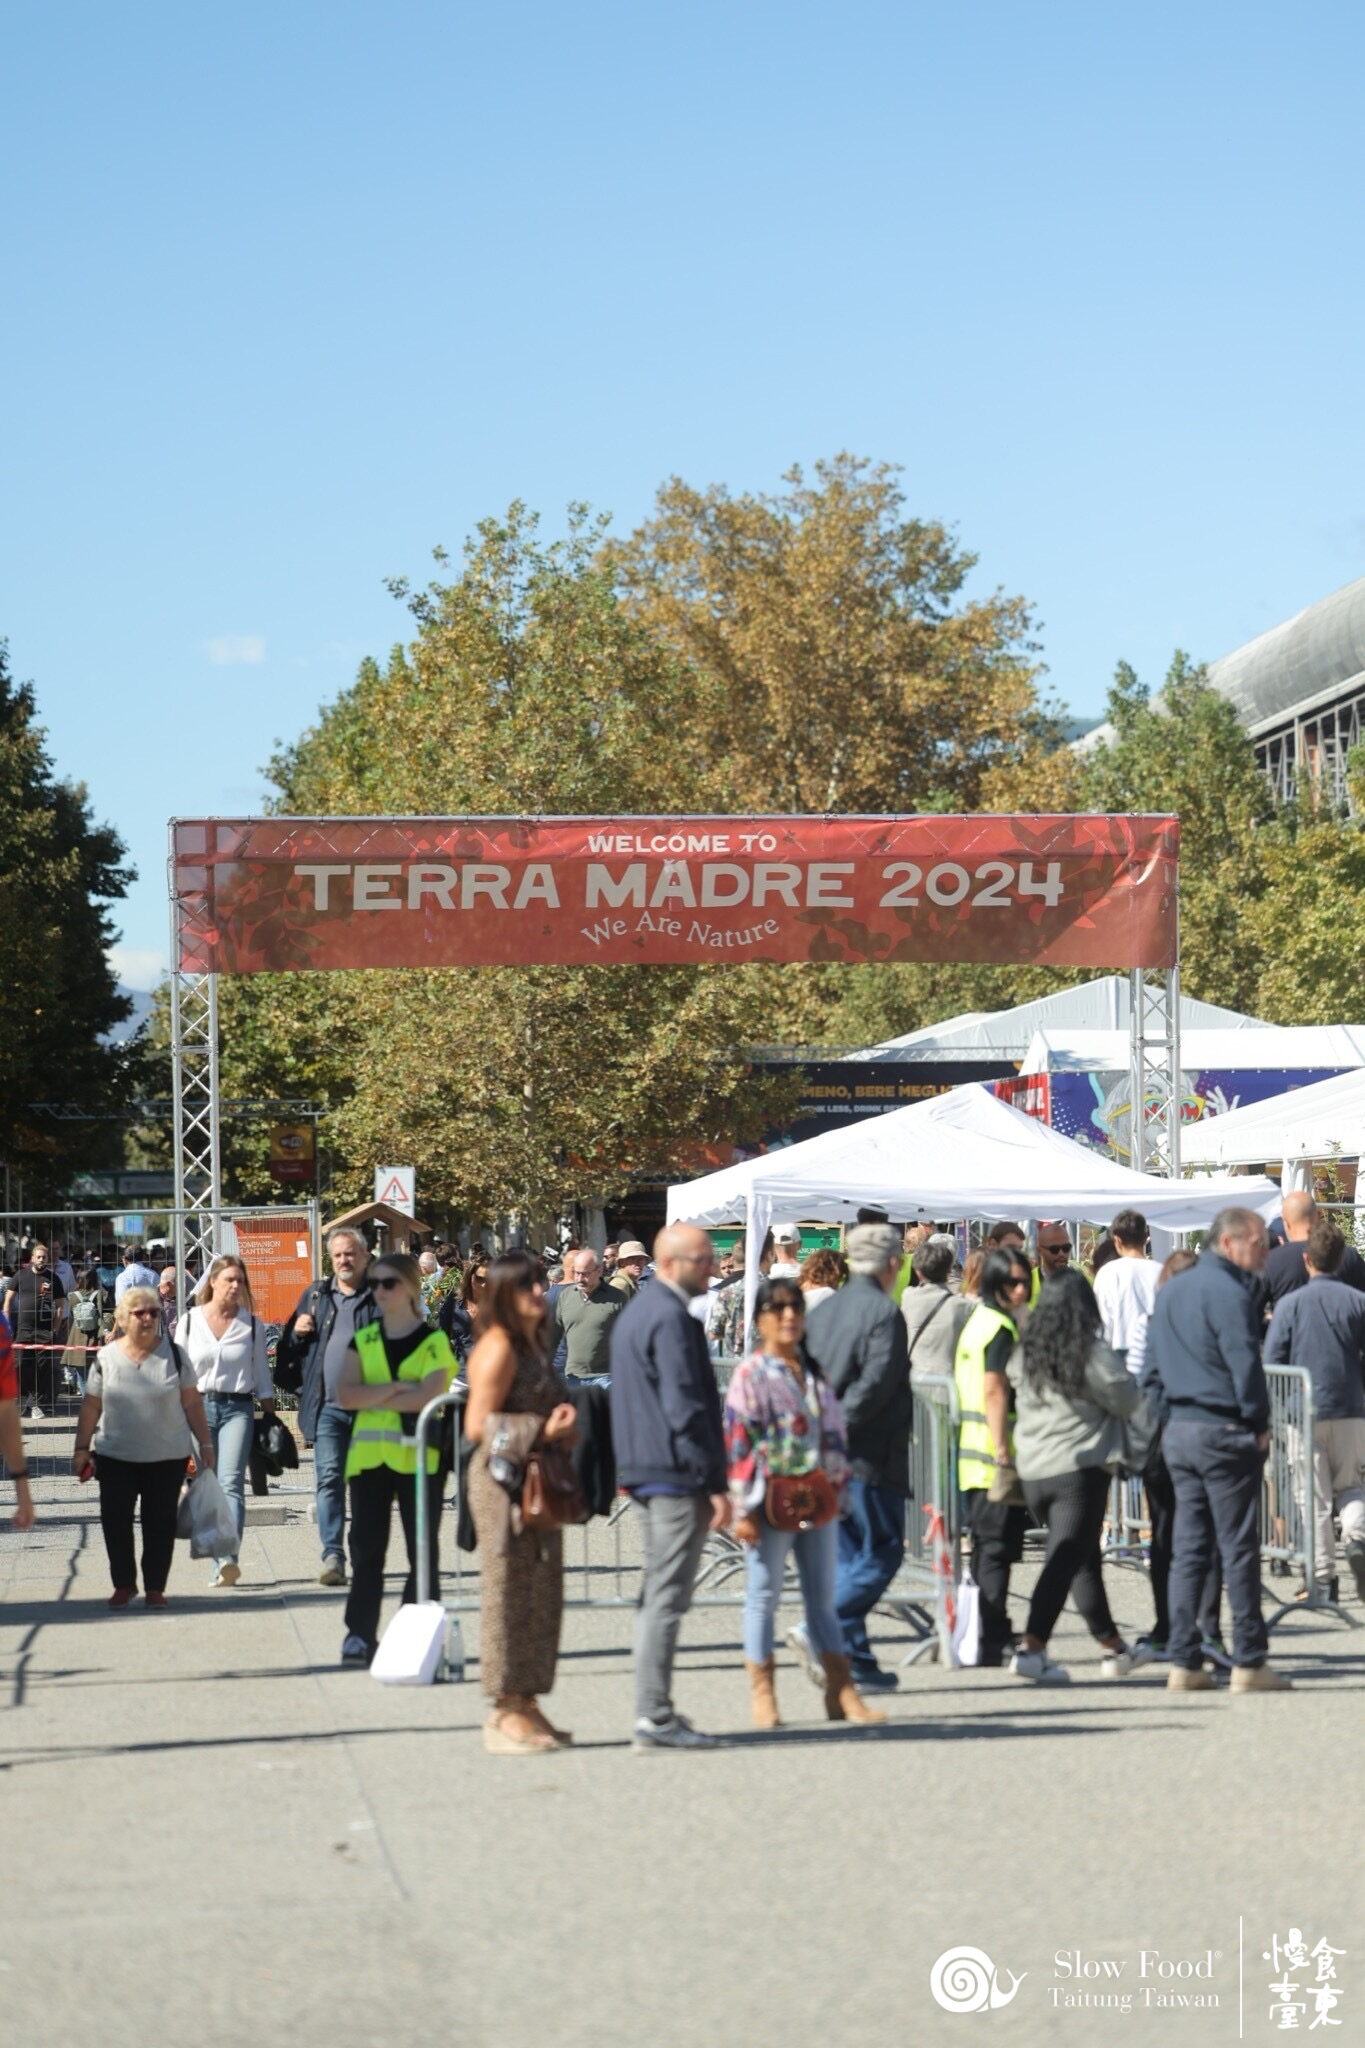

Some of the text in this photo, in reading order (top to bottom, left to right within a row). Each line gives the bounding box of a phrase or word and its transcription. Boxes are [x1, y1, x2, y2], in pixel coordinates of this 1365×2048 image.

[588, 834, 777, 853] WELCOME TO
[294, 861, 1064, 911] TERRA MADRE 2024
[581, 911, 780, 948] We Are Nature
[855, 1085, 896, 1098] BERE
[853, 1104, 882, 1113] DRINK
